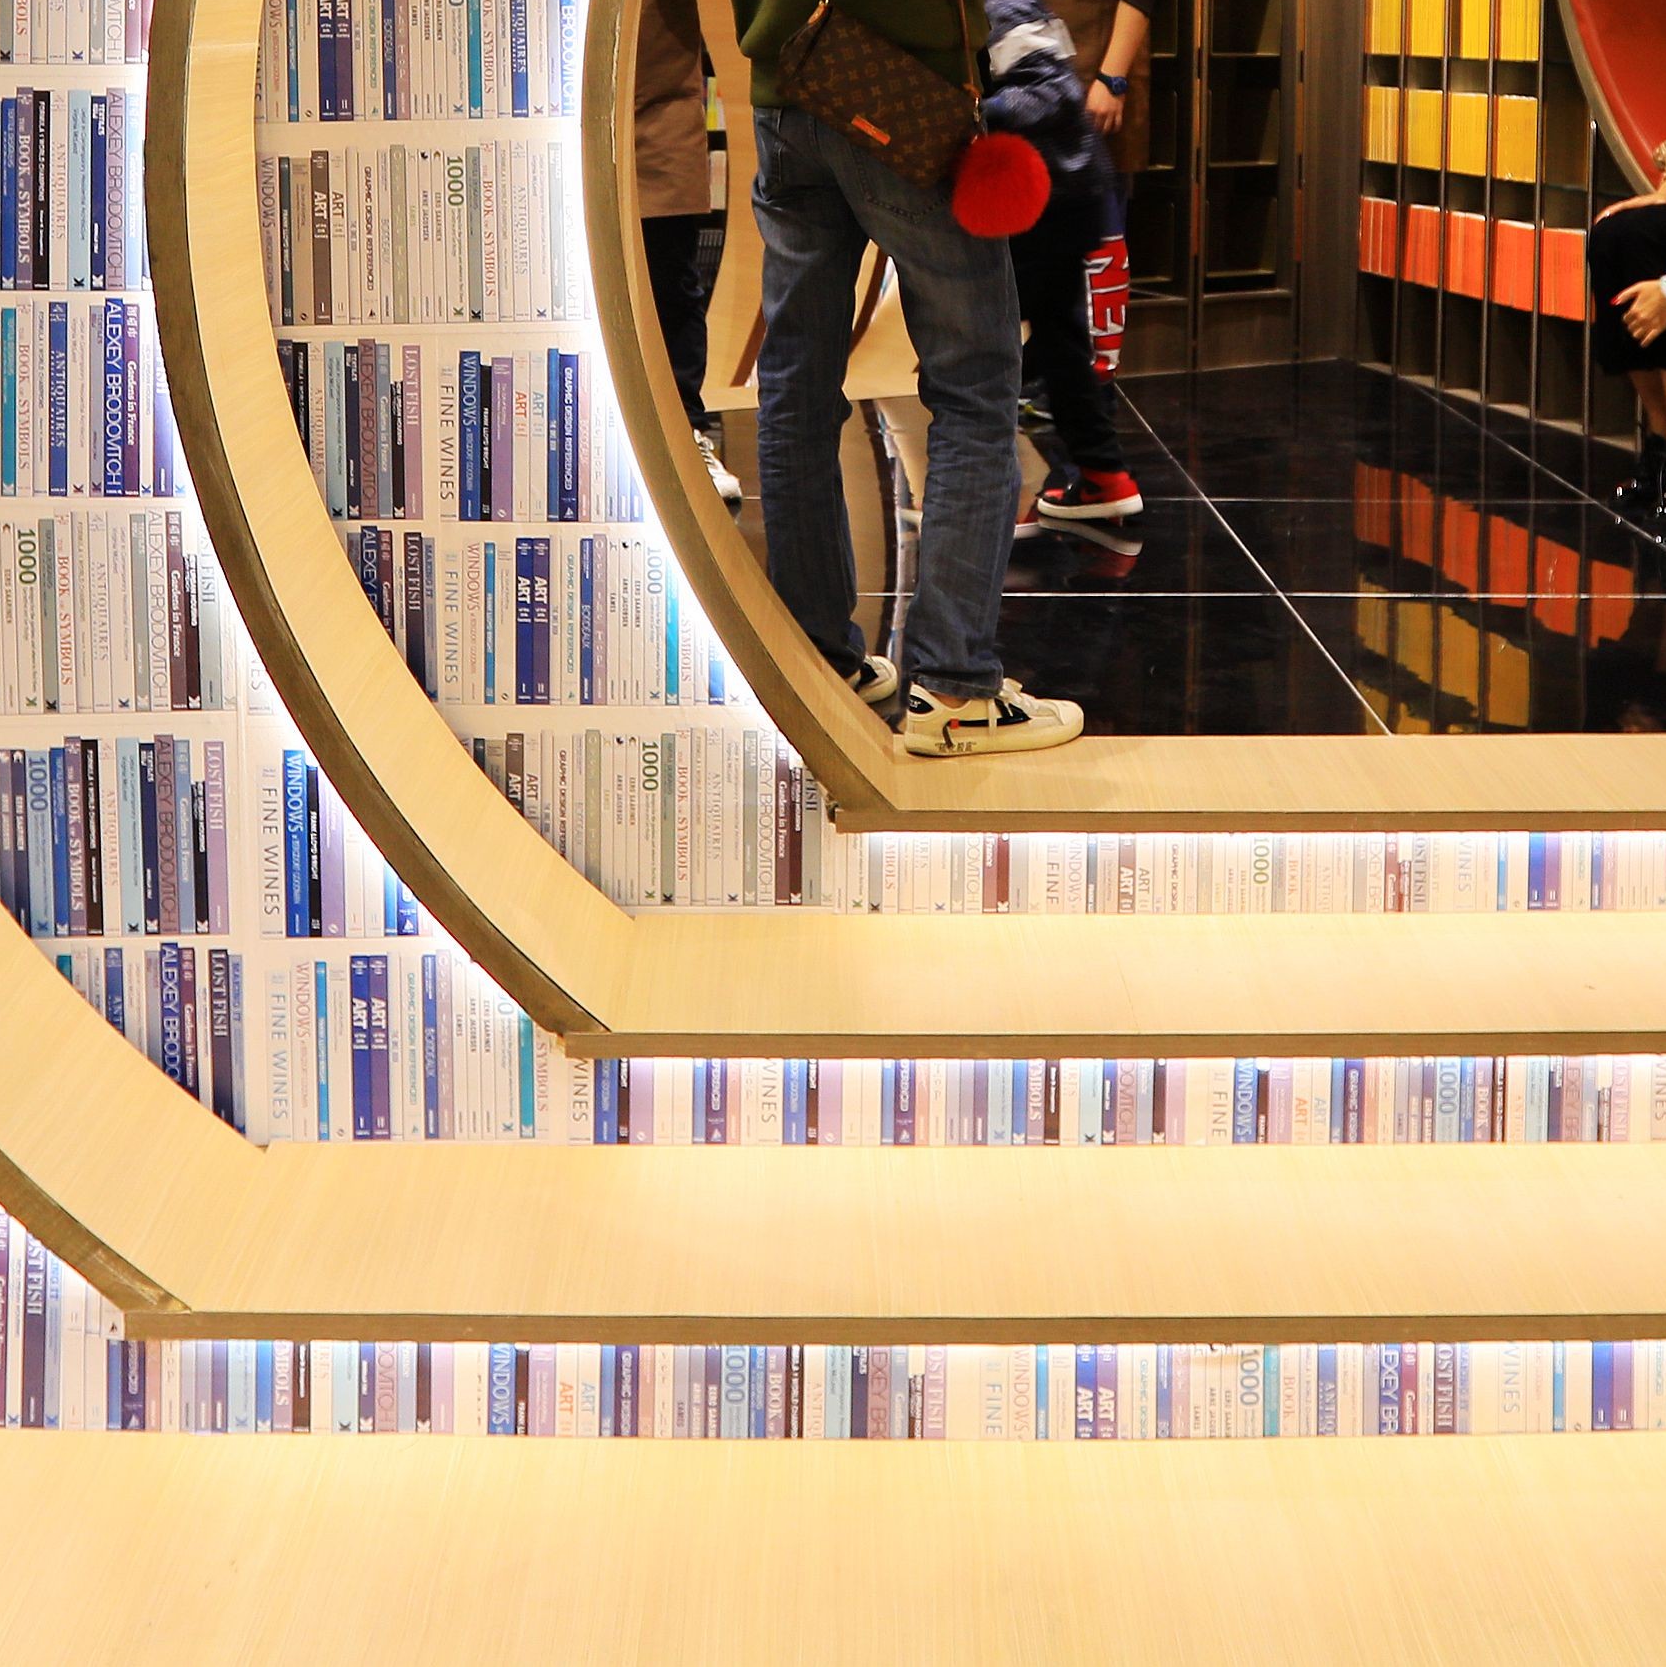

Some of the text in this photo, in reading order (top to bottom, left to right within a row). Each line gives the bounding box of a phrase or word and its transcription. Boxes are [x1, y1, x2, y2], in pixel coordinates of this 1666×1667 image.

[109, 92, 124, 158] ALEXEY
[18, 134, 30, 263] BOOK SYMBOLS
[332, 192, 344, 218] ART
[447, 157, 464, 206] 1000
[463, 356, 476, 427] WINDOWS
[441, 384, 454, 500] FINE WINES
[18, 529, 37, 584] 1000
[58, 557, 71, 685] BOOK SYMBOLS
[29, 757, 46, 811] 1000
[284, 750, 302, 832] WINDOWS
[263, 788, 279, 915] FINE WINES
[1252, 839, 1270, 884] 1000
[1046, 861, 1059, 904] FINE
[1138, 868, 1150, 894] ART
[296, 962, 310, 1037] WINDOWS
[372, 997, 386, 1029] ART
[272, 994, 287, 1119] FINE WINES
[1212, 1089, 1227, 1137] FINE
[1438, 1062, 1453, 1115] 1000
[1077, 1387, 1093, 1422] ART
[1239, 1349, 1259, 1406] 1000
[989, 1384, 1002, 1437] FINE
